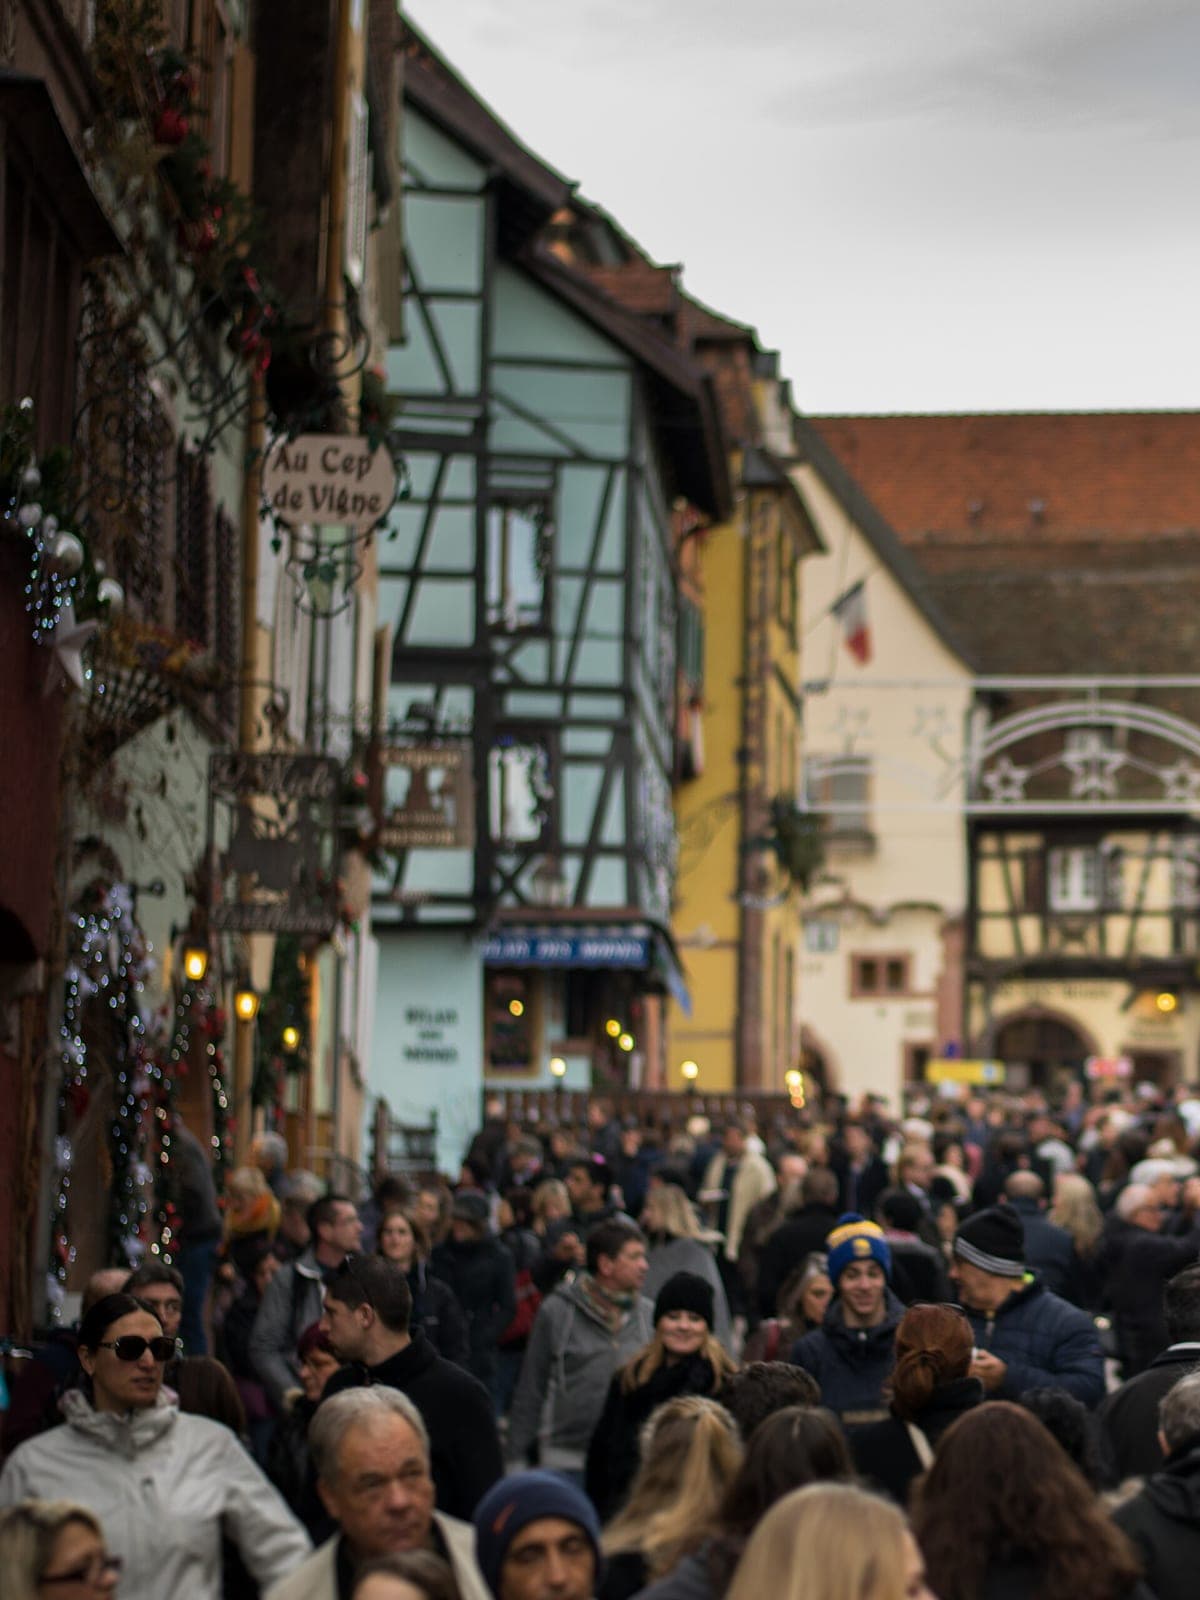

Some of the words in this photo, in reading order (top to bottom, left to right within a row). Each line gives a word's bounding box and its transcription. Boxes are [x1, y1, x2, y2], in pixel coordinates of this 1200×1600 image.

[272, 446, 308, 473] Au
[320, 446, 374, 481] Cep
[273, 483, 303, 510] de
[309, 484, 383, 520] Vigne
